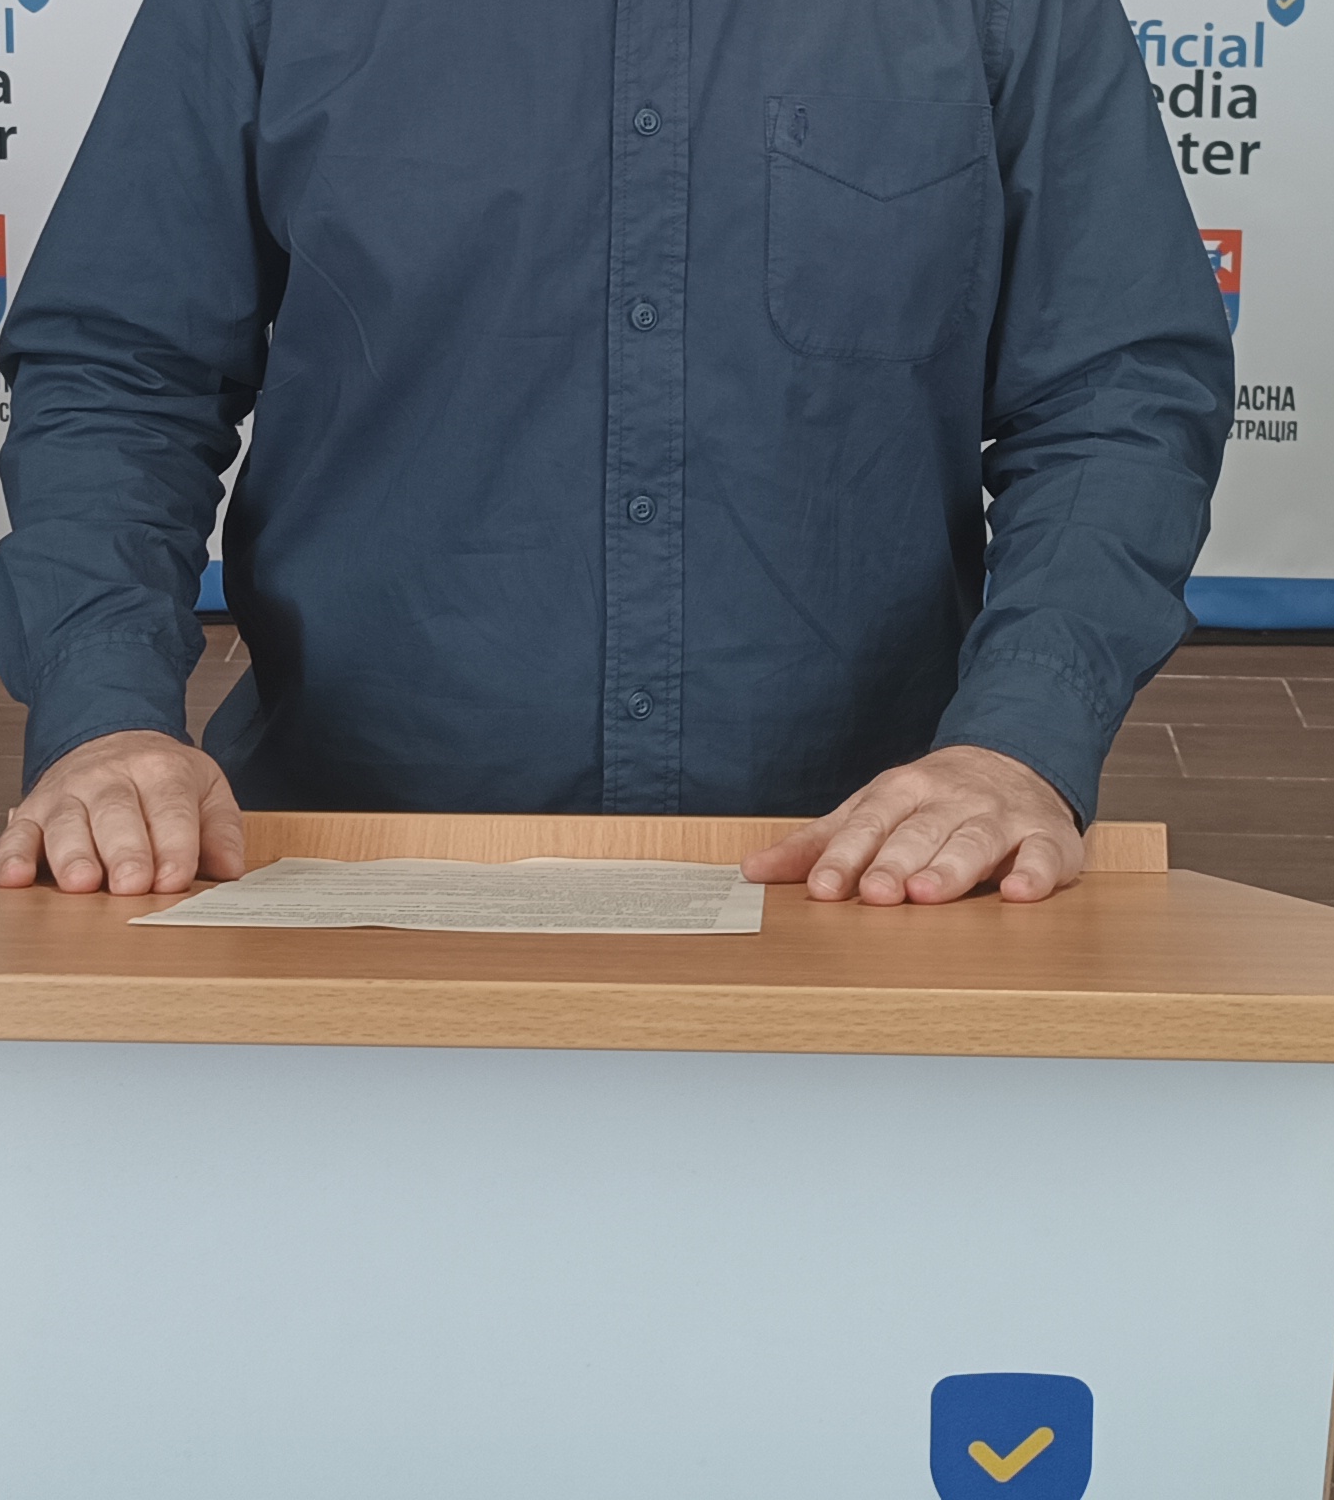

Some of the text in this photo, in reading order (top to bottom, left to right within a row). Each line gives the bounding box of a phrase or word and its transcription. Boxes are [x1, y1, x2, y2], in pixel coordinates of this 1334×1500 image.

[1128, 19, 1264, 68] ficial
[1150, 69, 1257, 119] dia
[1177, 132, 1261, 175] ter
[1237, 385, 1295, 411] АСНА
